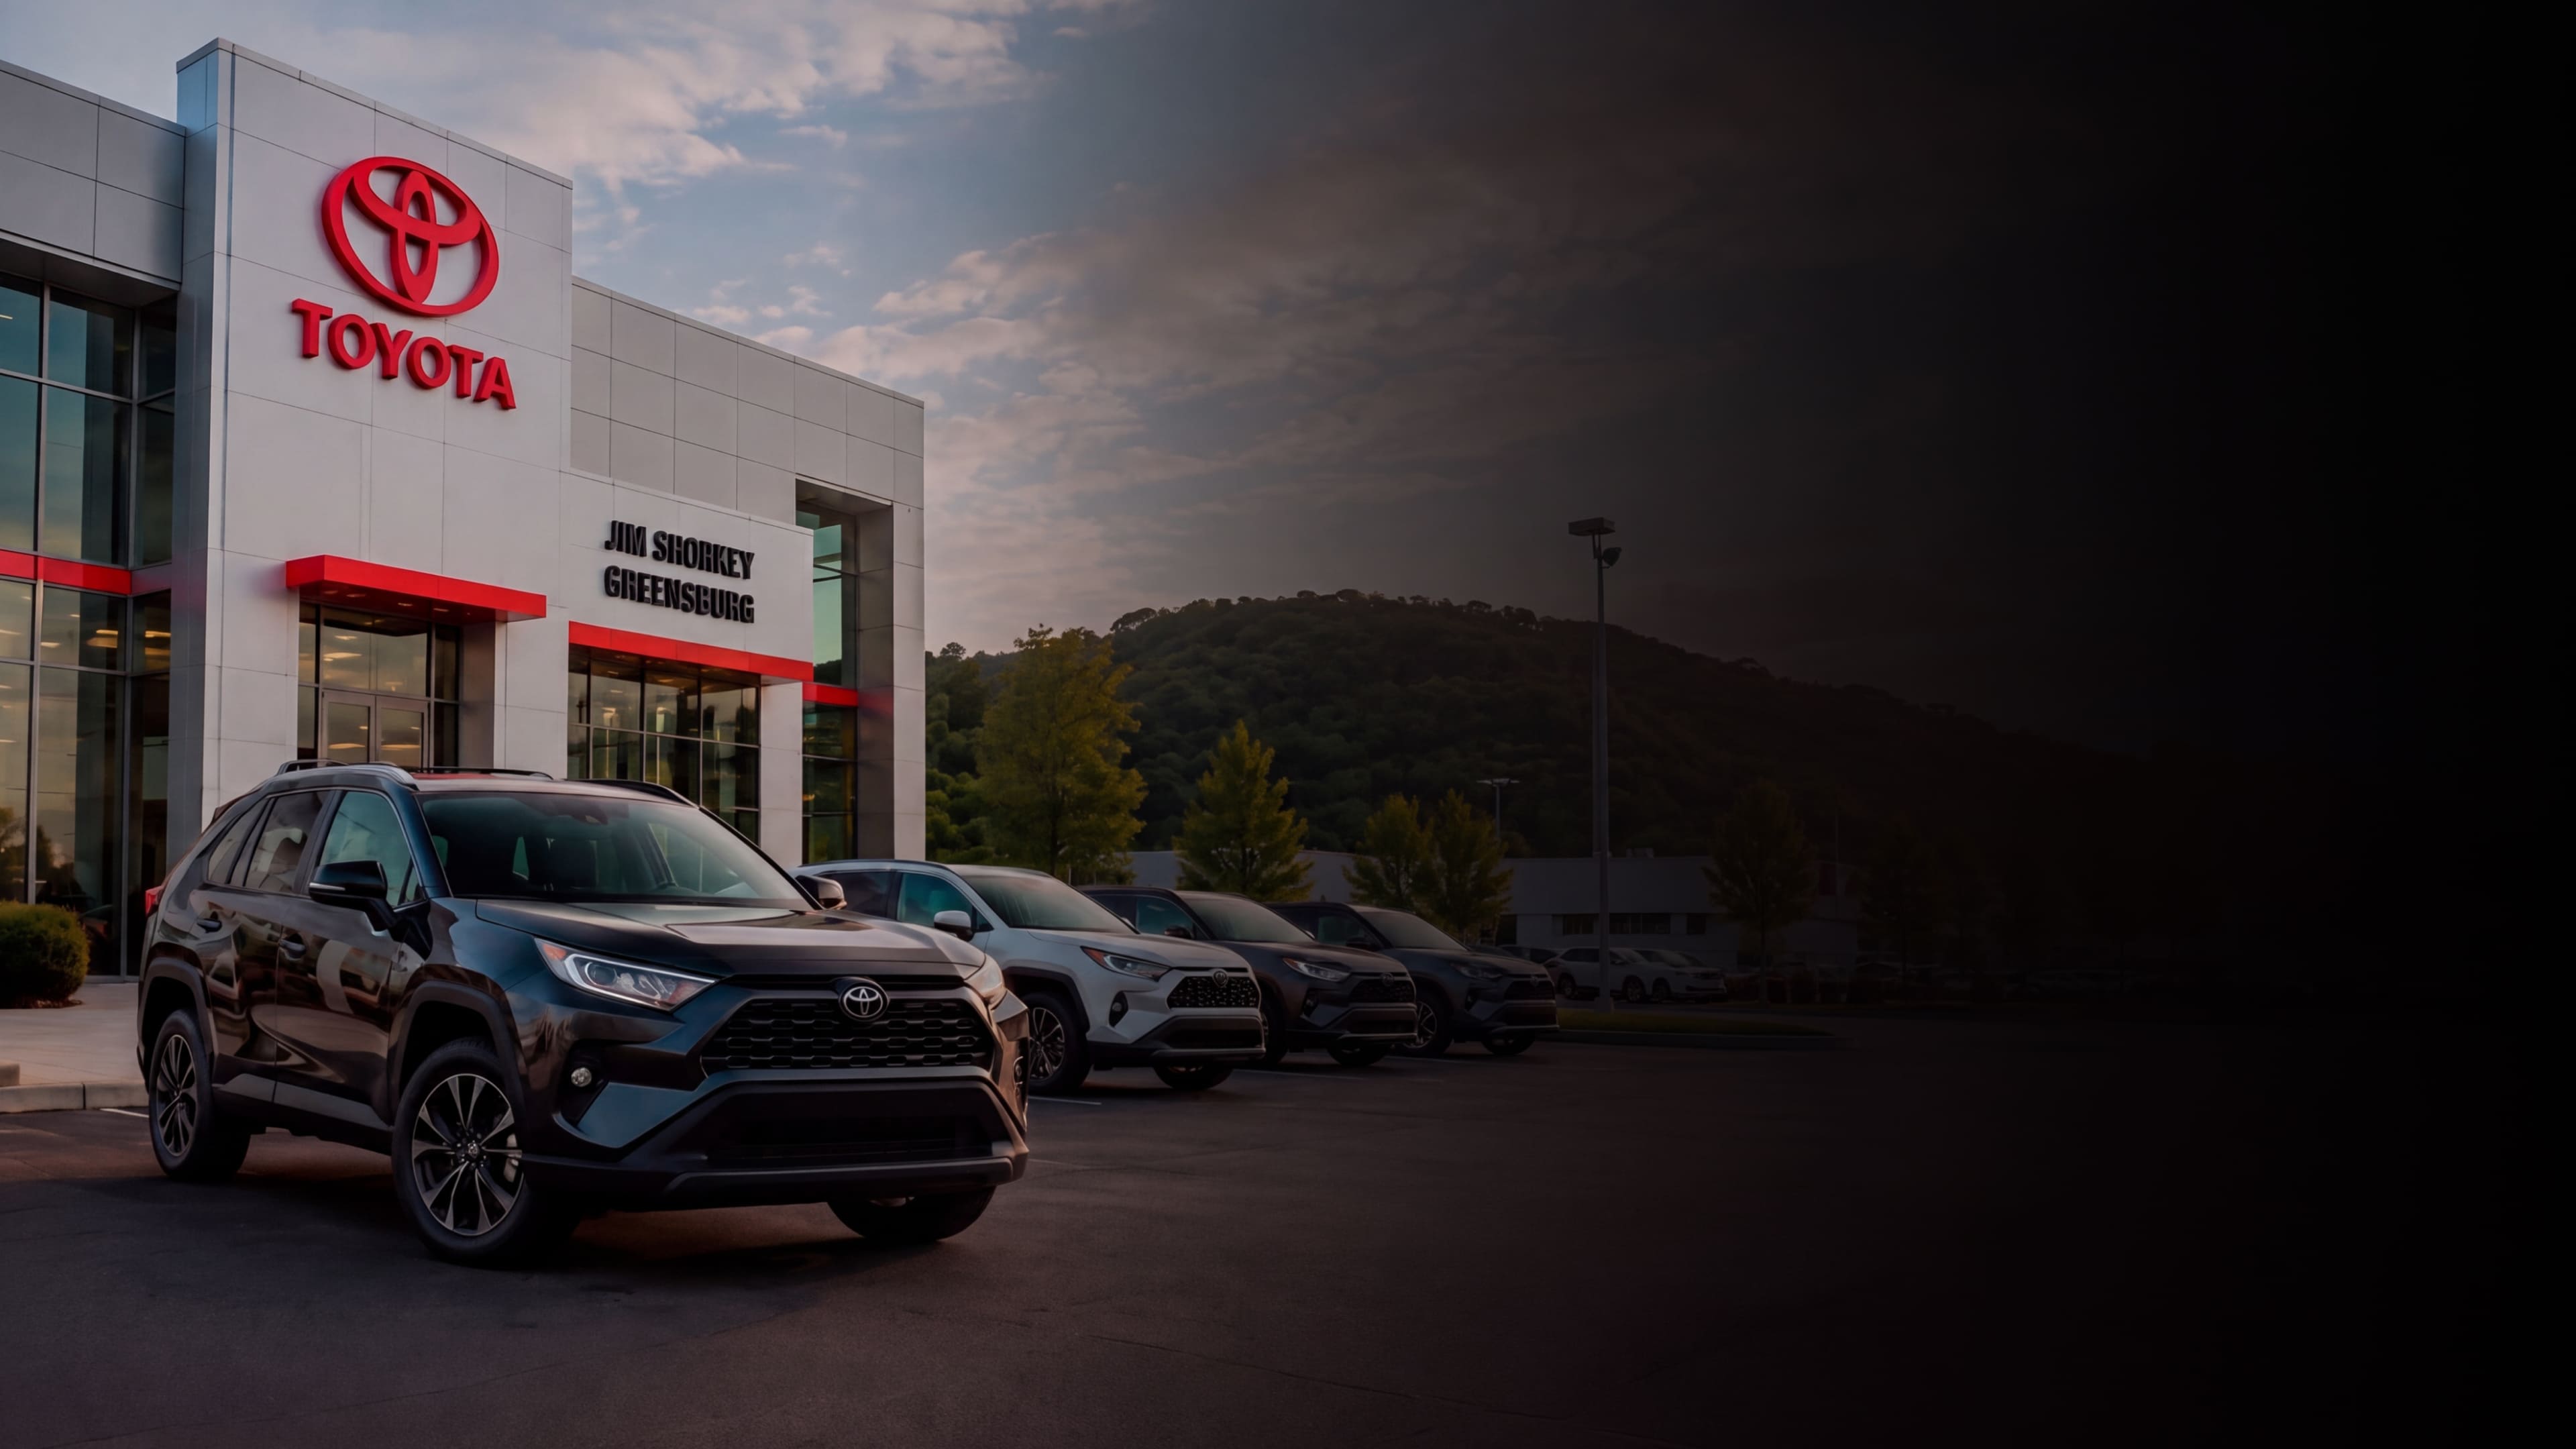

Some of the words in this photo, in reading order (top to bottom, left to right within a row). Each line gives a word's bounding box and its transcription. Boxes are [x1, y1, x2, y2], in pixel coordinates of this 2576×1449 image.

[291, 298, 517, 410] TOYOTA
[604, 520, 647, 557] JIM
[652, 530, 755, 580] SHORKEY
[604, 565, 755, 623] GREENSBURG
